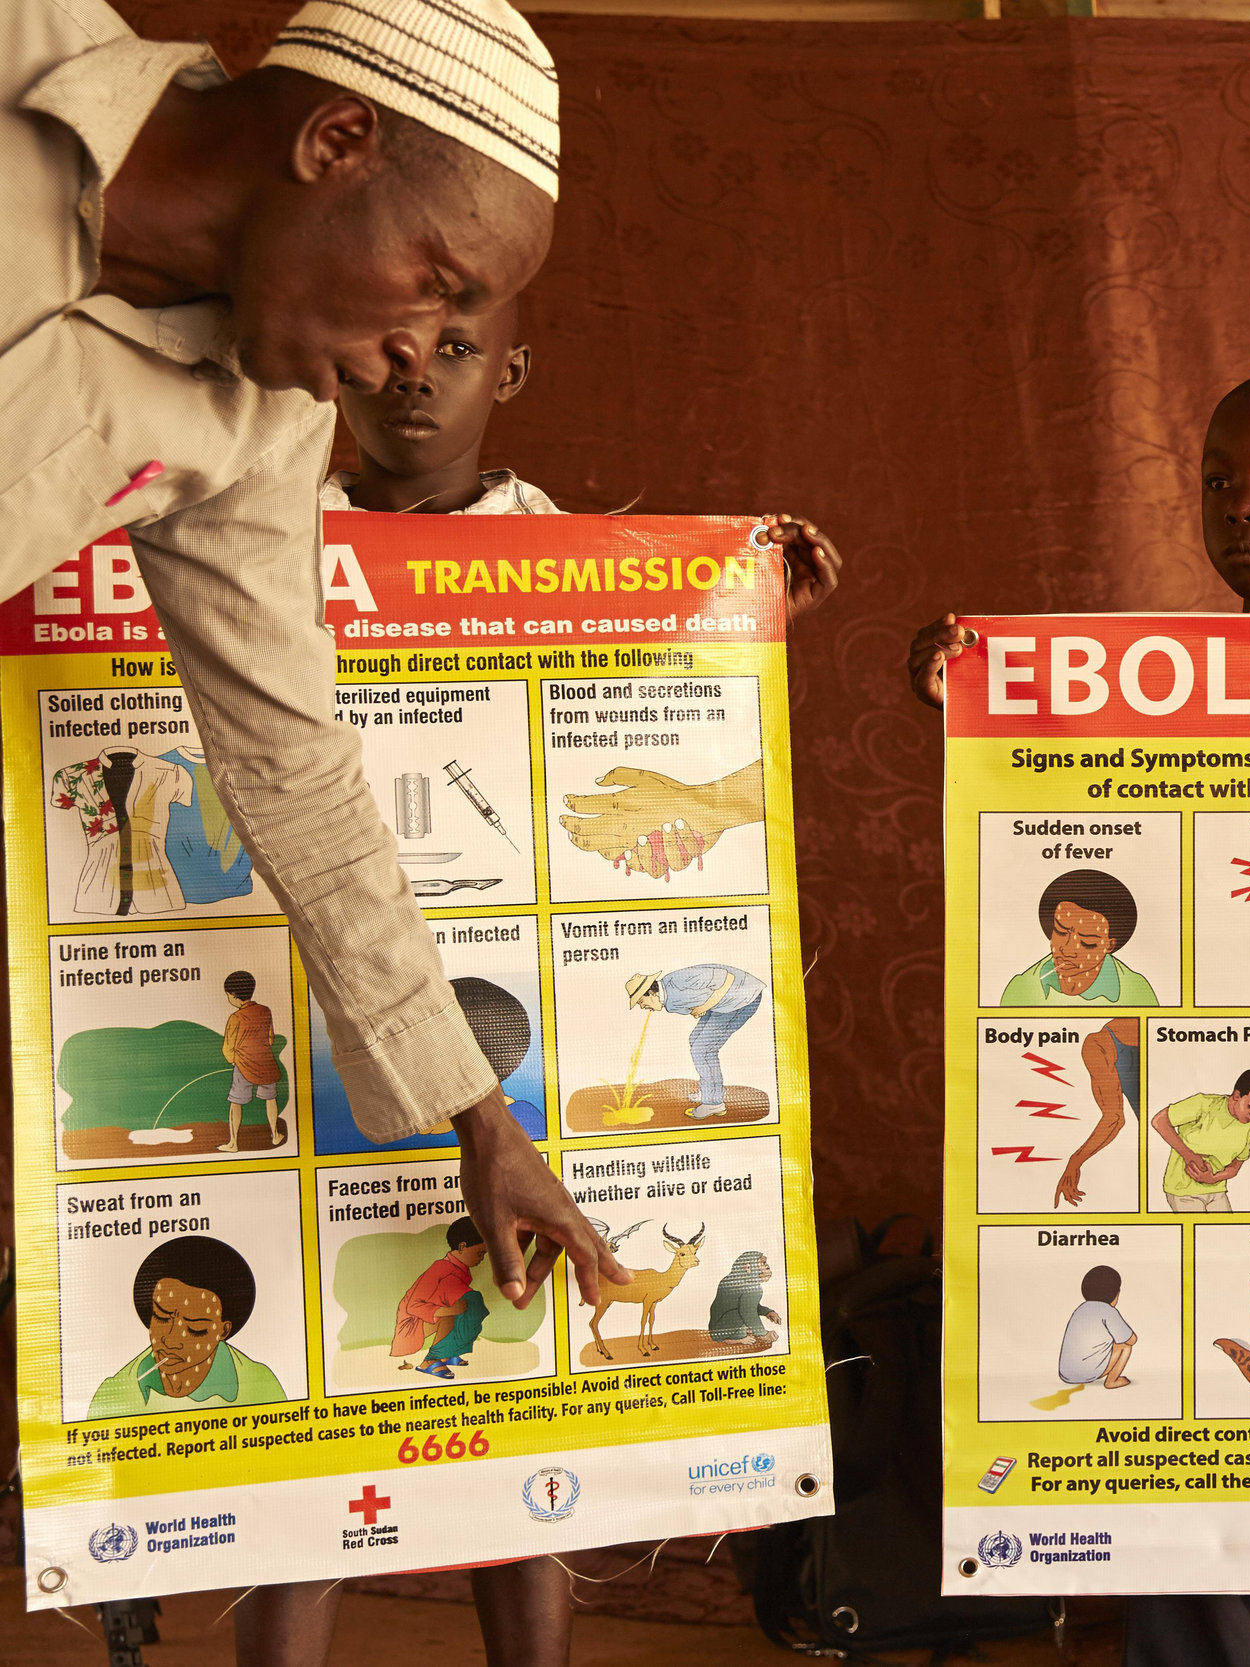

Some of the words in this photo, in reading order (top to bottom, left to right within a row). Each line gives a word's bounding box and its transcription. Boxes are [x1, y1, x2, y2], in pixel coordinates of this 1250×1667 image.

[33, 543, 379, 616] EBA
[407, 556, 756, 593] TRANSMISSION
[34, 622, 113, 643] Ebola
[123, 621, 148, 641] is
[345, 619, 450, 637] disease
[460, 618, 514, 635] that
[524, 620, 571, 633] can
[582, 614, 676, 632] caused
[685, 613, 757, 633] death
[550, 683, 595, 699] Blood
[603, 683, 631, 698] and
[639, 682, 720, 698] secretions
[550, 708, 588, 723] from
[595, 707, 657, 722] wounds
[664, 706, 699, 720] from
[707, 709, 724, 720] an
[552, 731, 617, 747] infected
[625, 734, 678, 749] person
[1012, 748, 1074, 772] Signs
[1081, 748, 1123, 767] and
[1088, 778, 1111, 797] of
[1117, 781, 1203, 797] contact
[1013, 820, 1083, 835] Sudden
[1090, 822, 1141, 834] onset
[1042, 844, 1061, 858] of
[1065, 844, 1112, 858] fever
[986, 1028, 1033, 1047] Body
[1038, 1028, 1079, 1048] pain
[1157, 1027, 1237, 1041] Stomach
[573, 1160, 645, 1179] Handling
[652, 1154, 709, 1172] wildlife
[573, 1185, 639, 1203] whether
[647, 1181, 684, 1197] alive
[692, 1182, 707, 1194] or
[714, 1174, 751, 1192] dead
[1039, 1230, 1118, 1245] Diarrhea
[1096, 1426, 1149, 1442] Avoid
[1155, 1426, 1209, 1441] direct
[398, 1430, 489, 1464] 6666
[689, 1455, 749, 1479] unicef
[1029, 1453, 1092, 1471] Report
[1097, 1451, 1118, 1466] all
[1125, 1450, 1218, 1469] suspected
[689, 1484, 706, 1495] for
[709, 1482, 744, 1493] every
[747, 1477, 775, 1489] child
[1032, 1477, 1061, 1491] For
[1067, 1480, 1100, 1494] any
[1105, 1474, 1179, 1493] queries,
[1185, 1473, 1216, 1488] call
[146, 1518, 186, 1534] World
[191, 1513, 235, 1529] Health
[343, 1528, 368, 1538] South
[371, 1526, 397, 1534] Sudan
[148, 1532, 235, 1552] Organization
[343, 1538, 363, 1549] Red
[368, 1536, 398, 1546] Cross
[1029, 1533, 1065, 1545] World
[1071, 1532, 1111, 1544] Health
[1031, 1550, 1109, 1564] Organization
